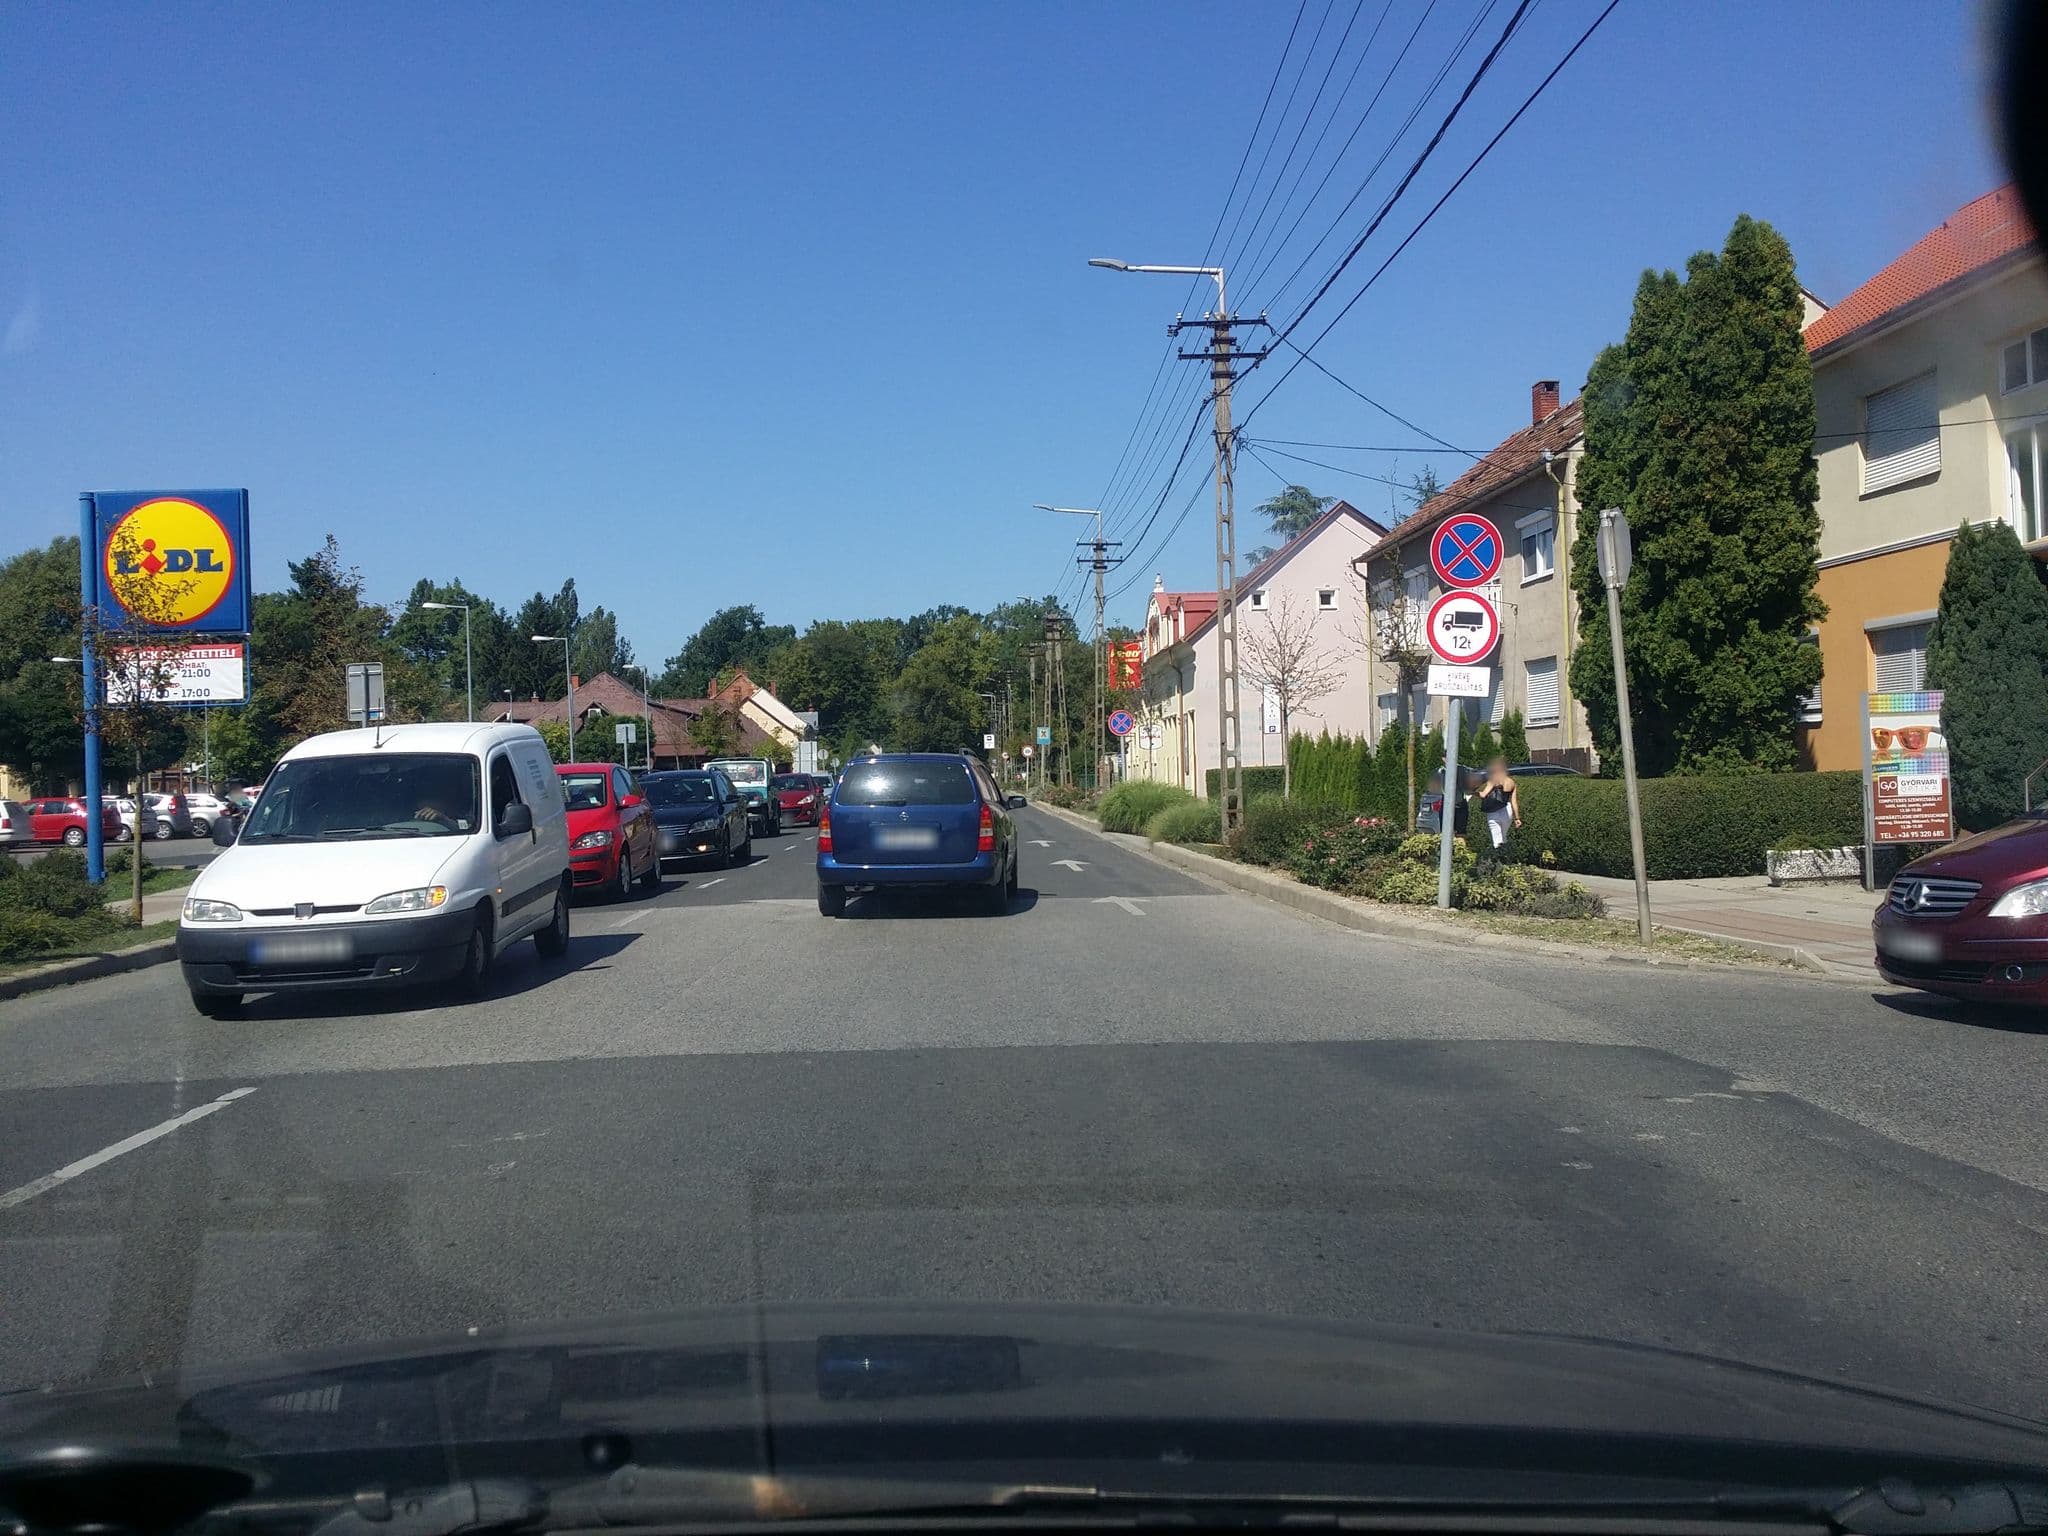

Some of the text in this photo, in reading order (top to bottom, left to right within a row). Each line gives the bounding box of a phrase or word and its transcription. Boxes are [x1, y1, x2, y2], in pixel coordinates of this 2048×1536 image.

[1452, 635, 1472, 650] 12t
[181, 668, 211, 678] 21:00
[181, 688, 211, 698] 17:00
